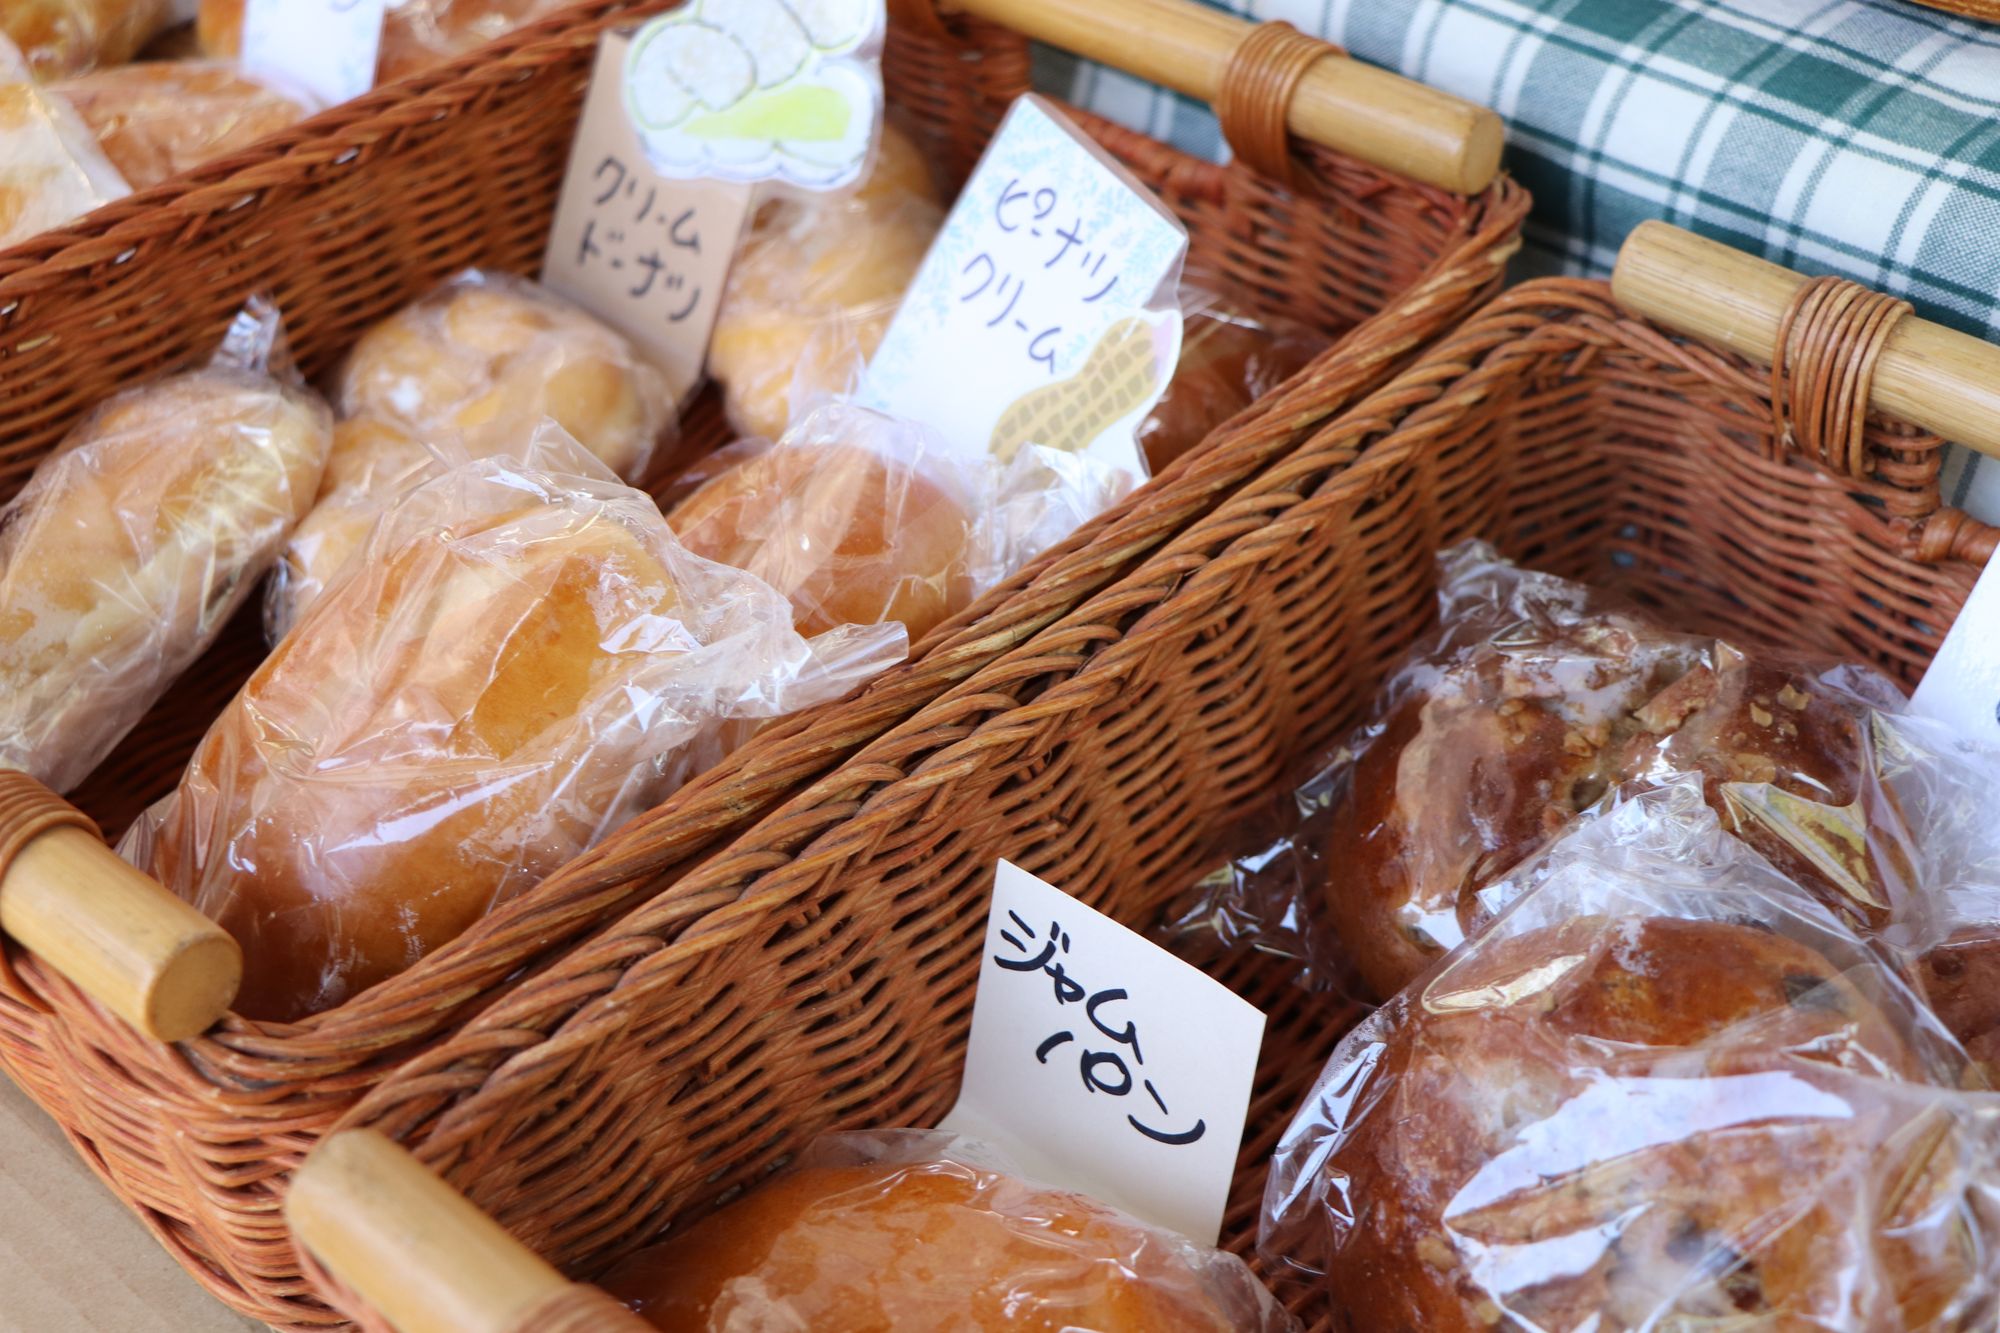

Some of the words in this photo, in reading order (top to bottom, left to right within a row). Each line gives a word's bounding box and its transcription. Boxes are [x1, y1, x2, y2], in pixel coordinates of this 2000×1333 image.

[595, 155, 700, 253] クリーム
[961, 253, 1061, 375] クリーム
[994, 909, 1143, 1066] ジャム
[1036, 1031, 1206, 1145] パン
